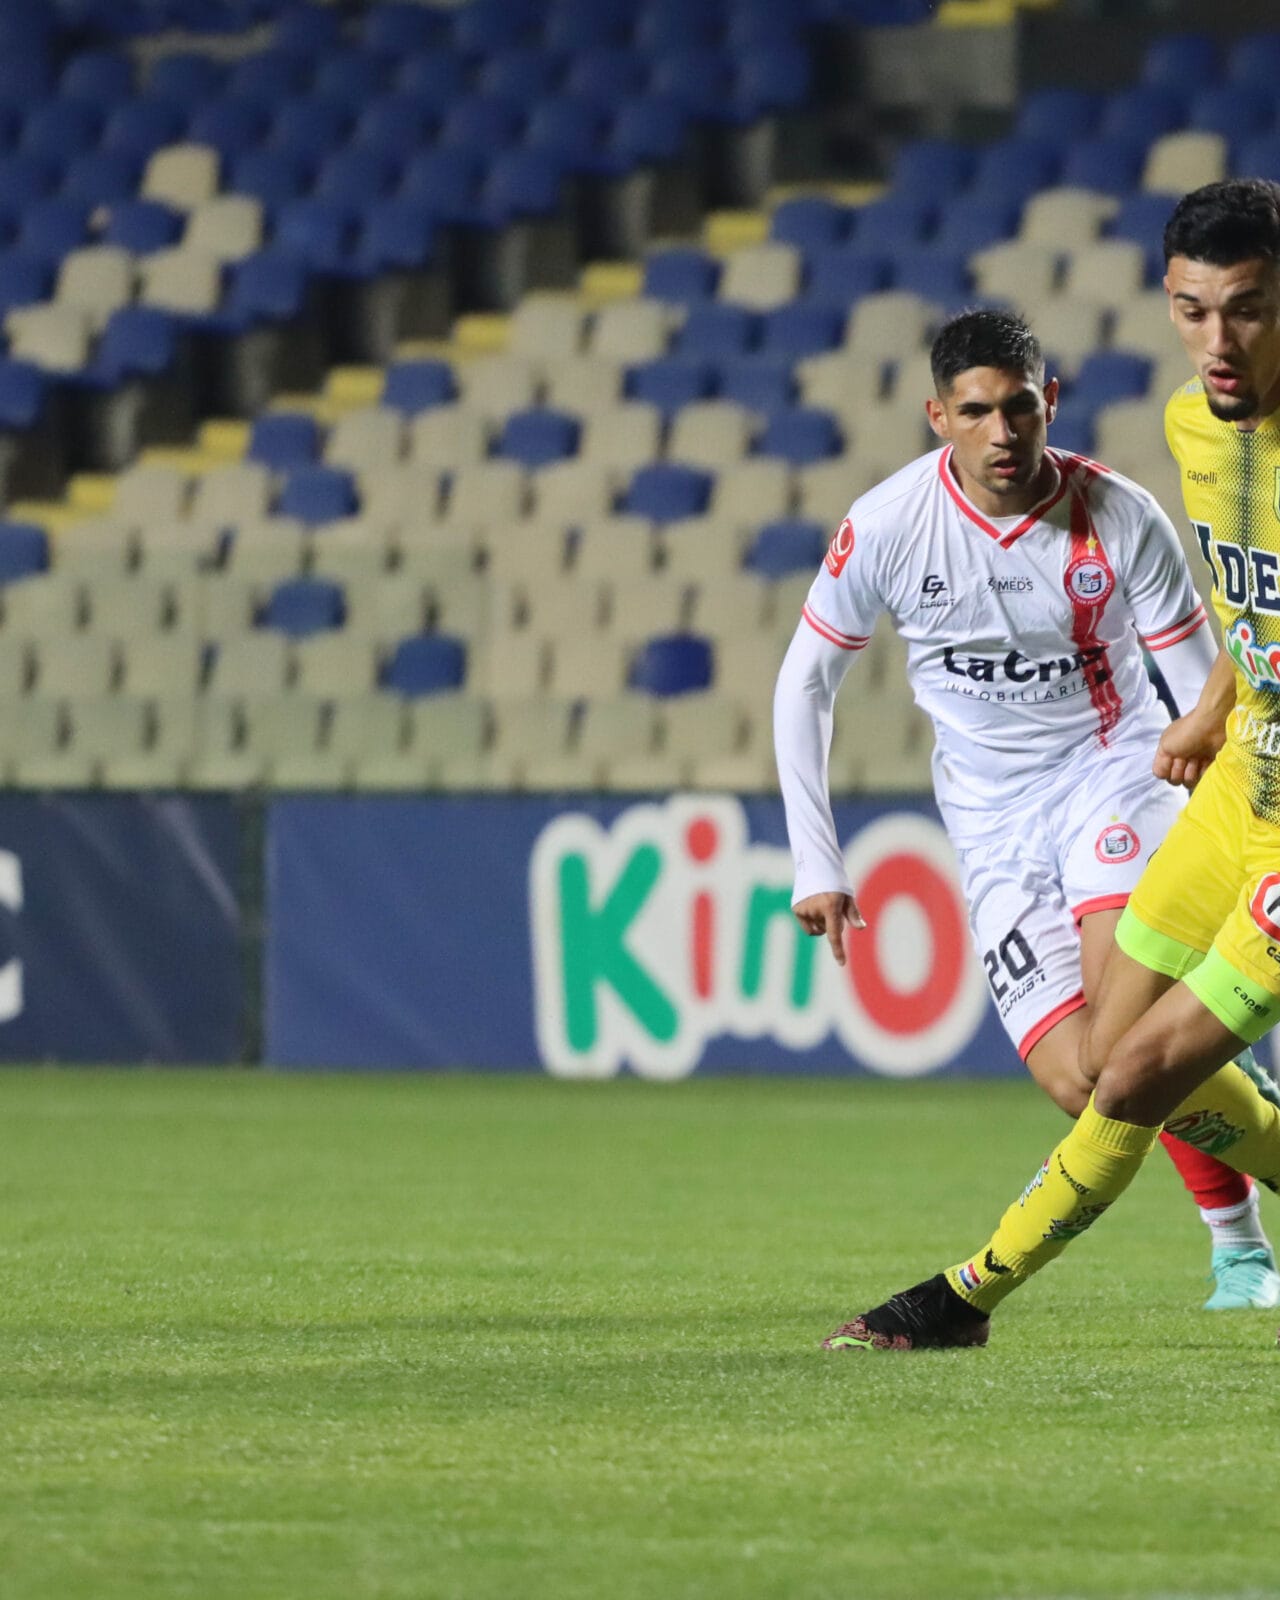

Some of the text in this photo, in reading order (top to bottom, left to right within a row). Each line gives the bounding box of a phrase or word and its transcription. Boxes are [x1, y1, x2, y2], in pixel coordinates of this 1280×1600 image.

[1186, 468, 1218, 486] capelli
[997, 580, 1034, 592] MEDS
[943, 646, 996, 683] La
[944, 676, 1091, 702] INMOBILIARIA
[983, 928, 1038, 1001] 20
